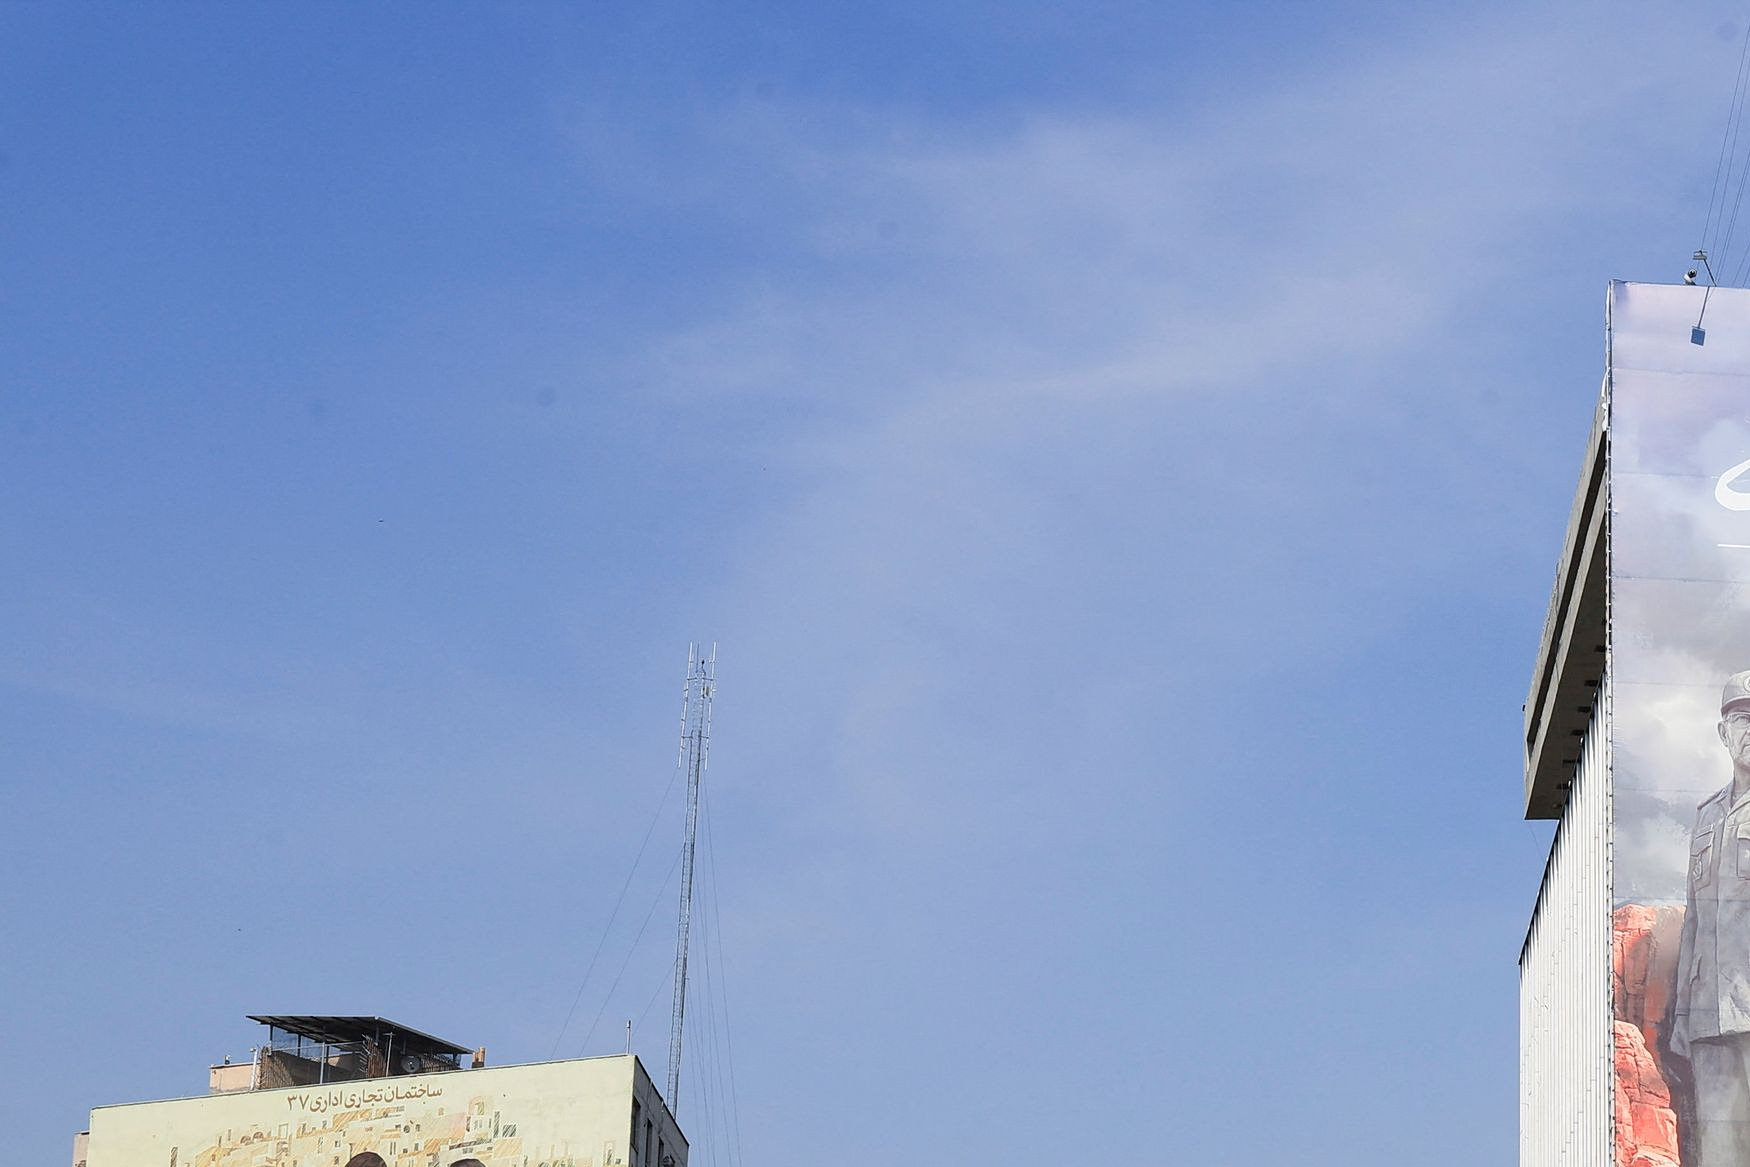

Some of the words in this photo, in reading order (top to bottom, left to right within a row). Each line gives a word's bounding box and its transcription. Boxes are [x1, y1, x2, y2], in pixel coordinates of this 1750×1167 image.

[287, 1093, 310, 1111] ۳۷
[310, 1091, 343, 1113] اداری
[344, 1089, 383, 1108] تجاری
[384, 1083, 443, 1105] ساختمان
